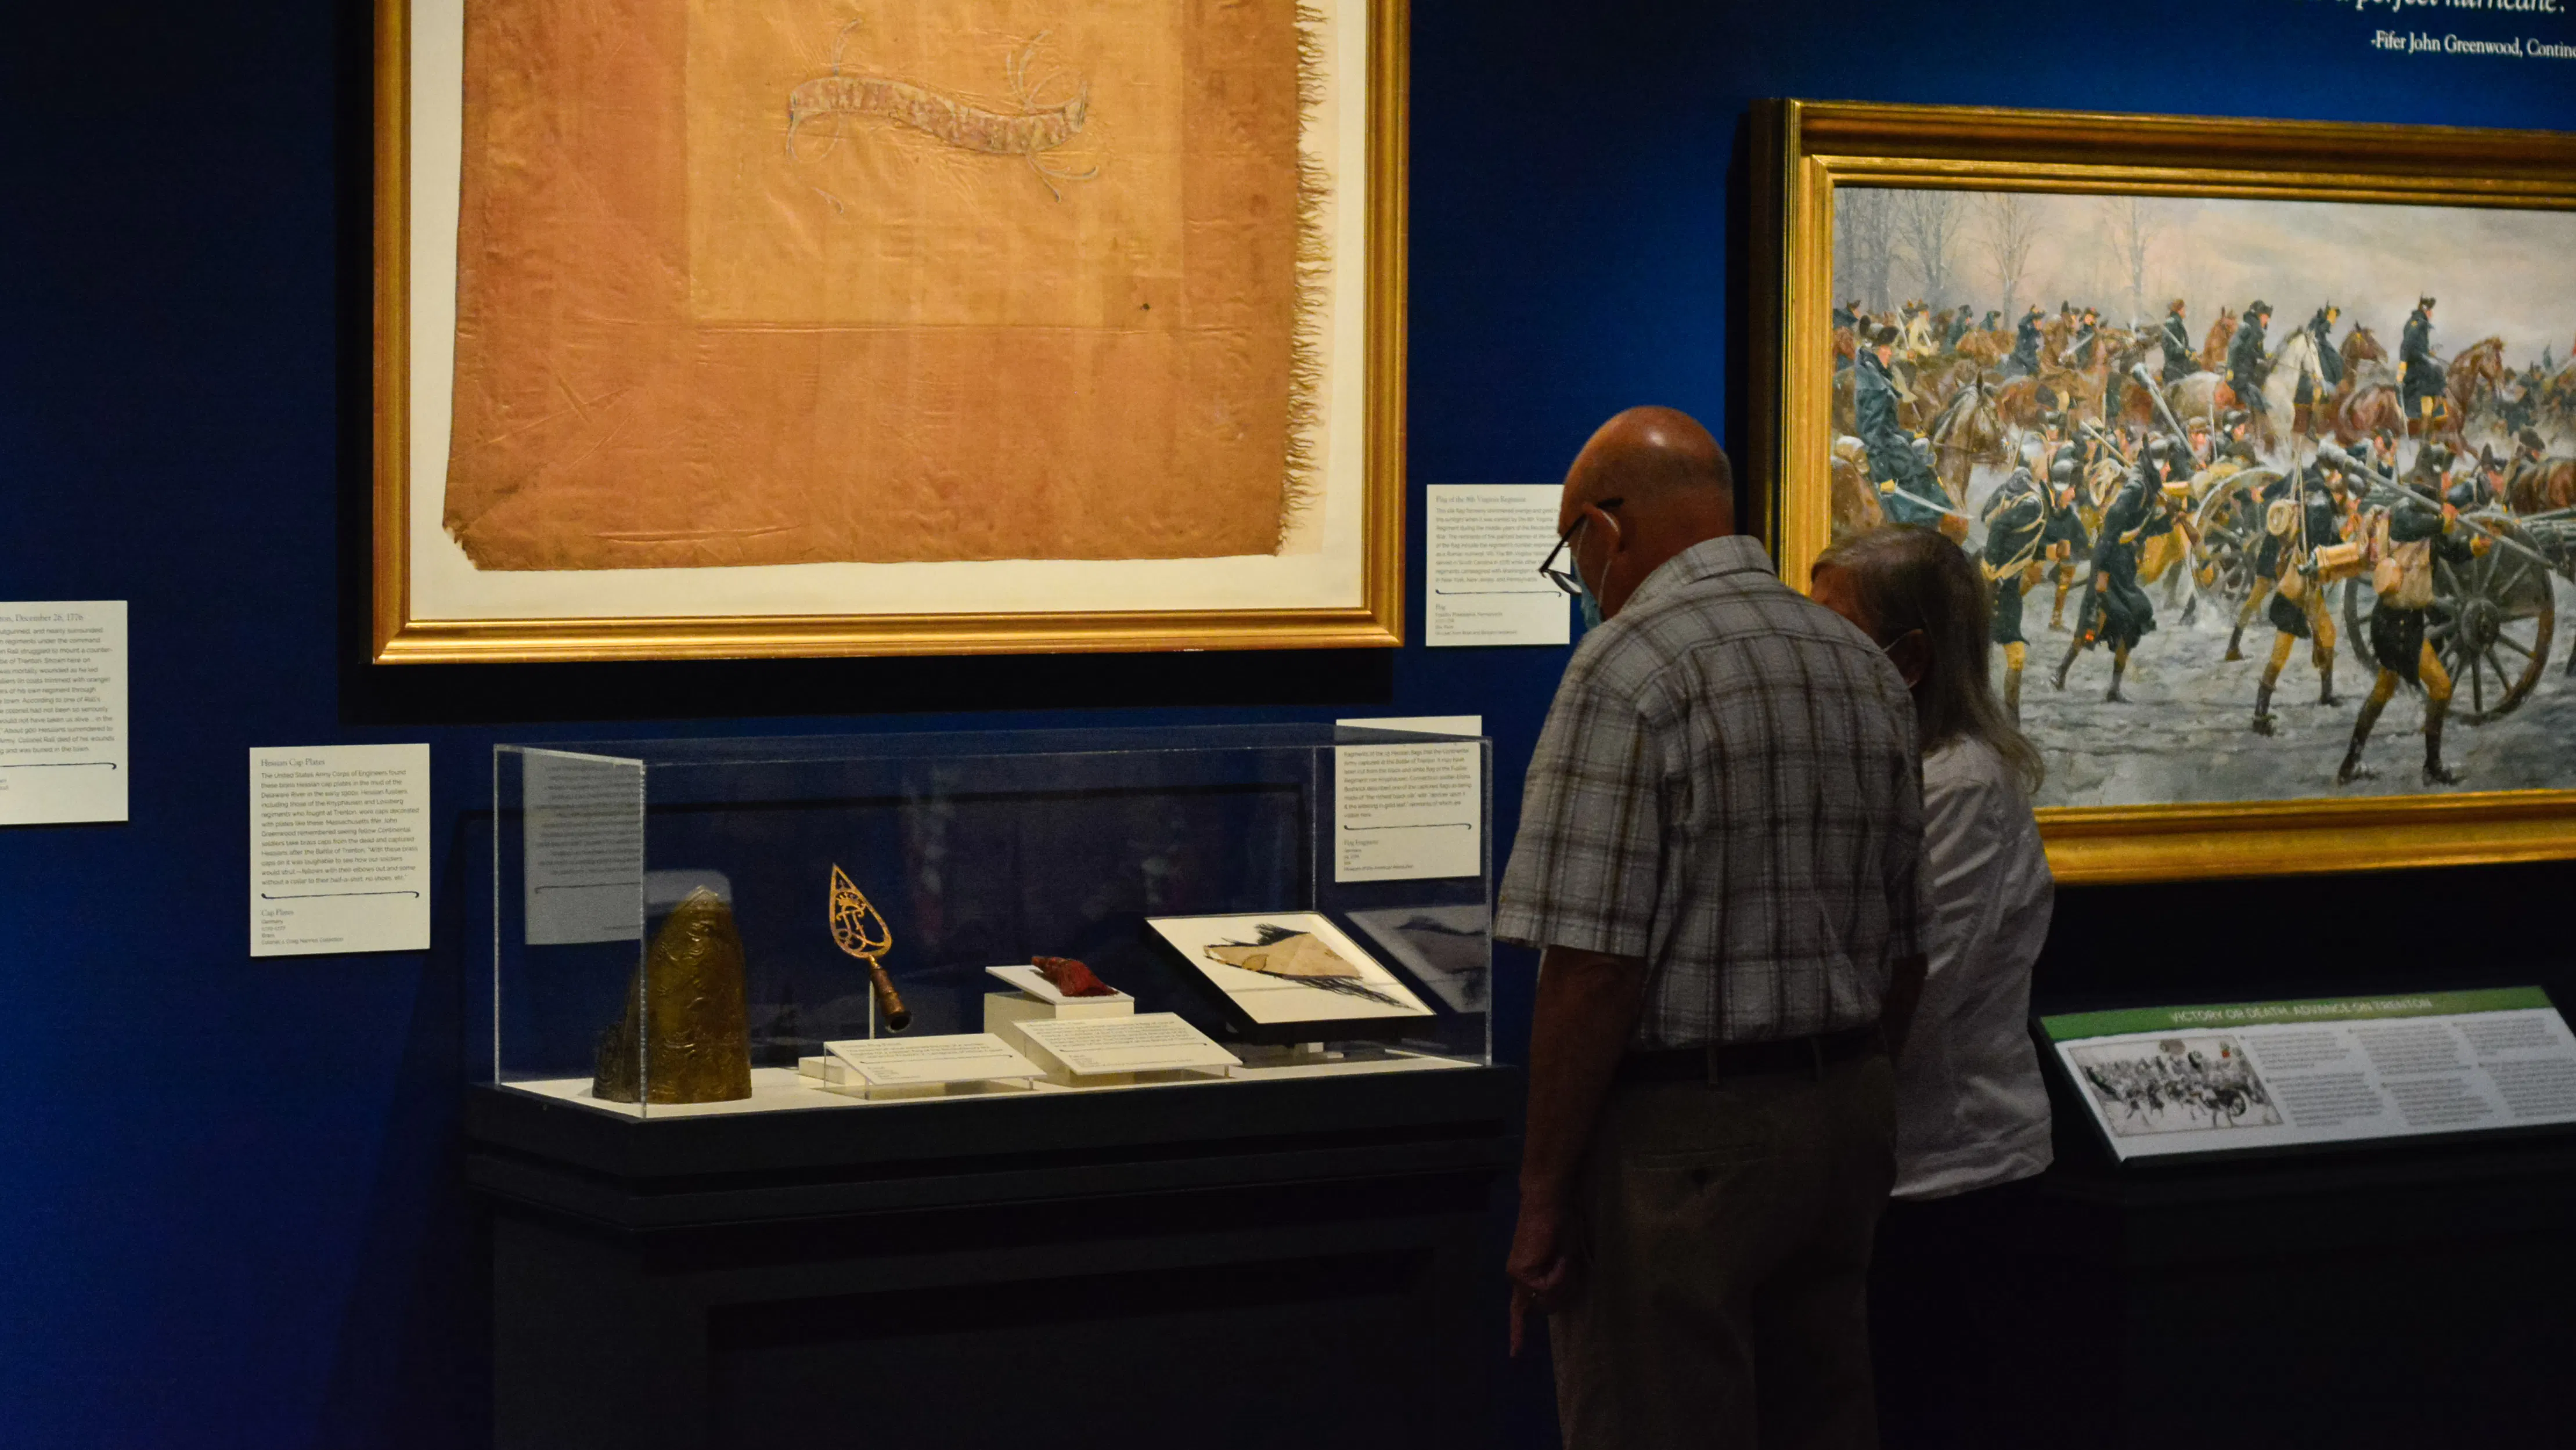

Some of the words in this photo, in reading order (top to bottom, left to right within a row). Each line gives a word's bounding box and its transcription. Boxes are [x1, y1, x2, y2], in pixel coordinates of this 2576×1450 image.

[2409, 31, 2441, 56] John
[2444, 34, 2523, 57] Greenwood,
[289, 758, 303, 768] Cap
[306, 809, 325, 817] fought
[2170, 1009, 2222, 1022] VICTORY
[2225, 1008, 2244, 1019] OR
[2353, 1002, 2372, 1012] ON
